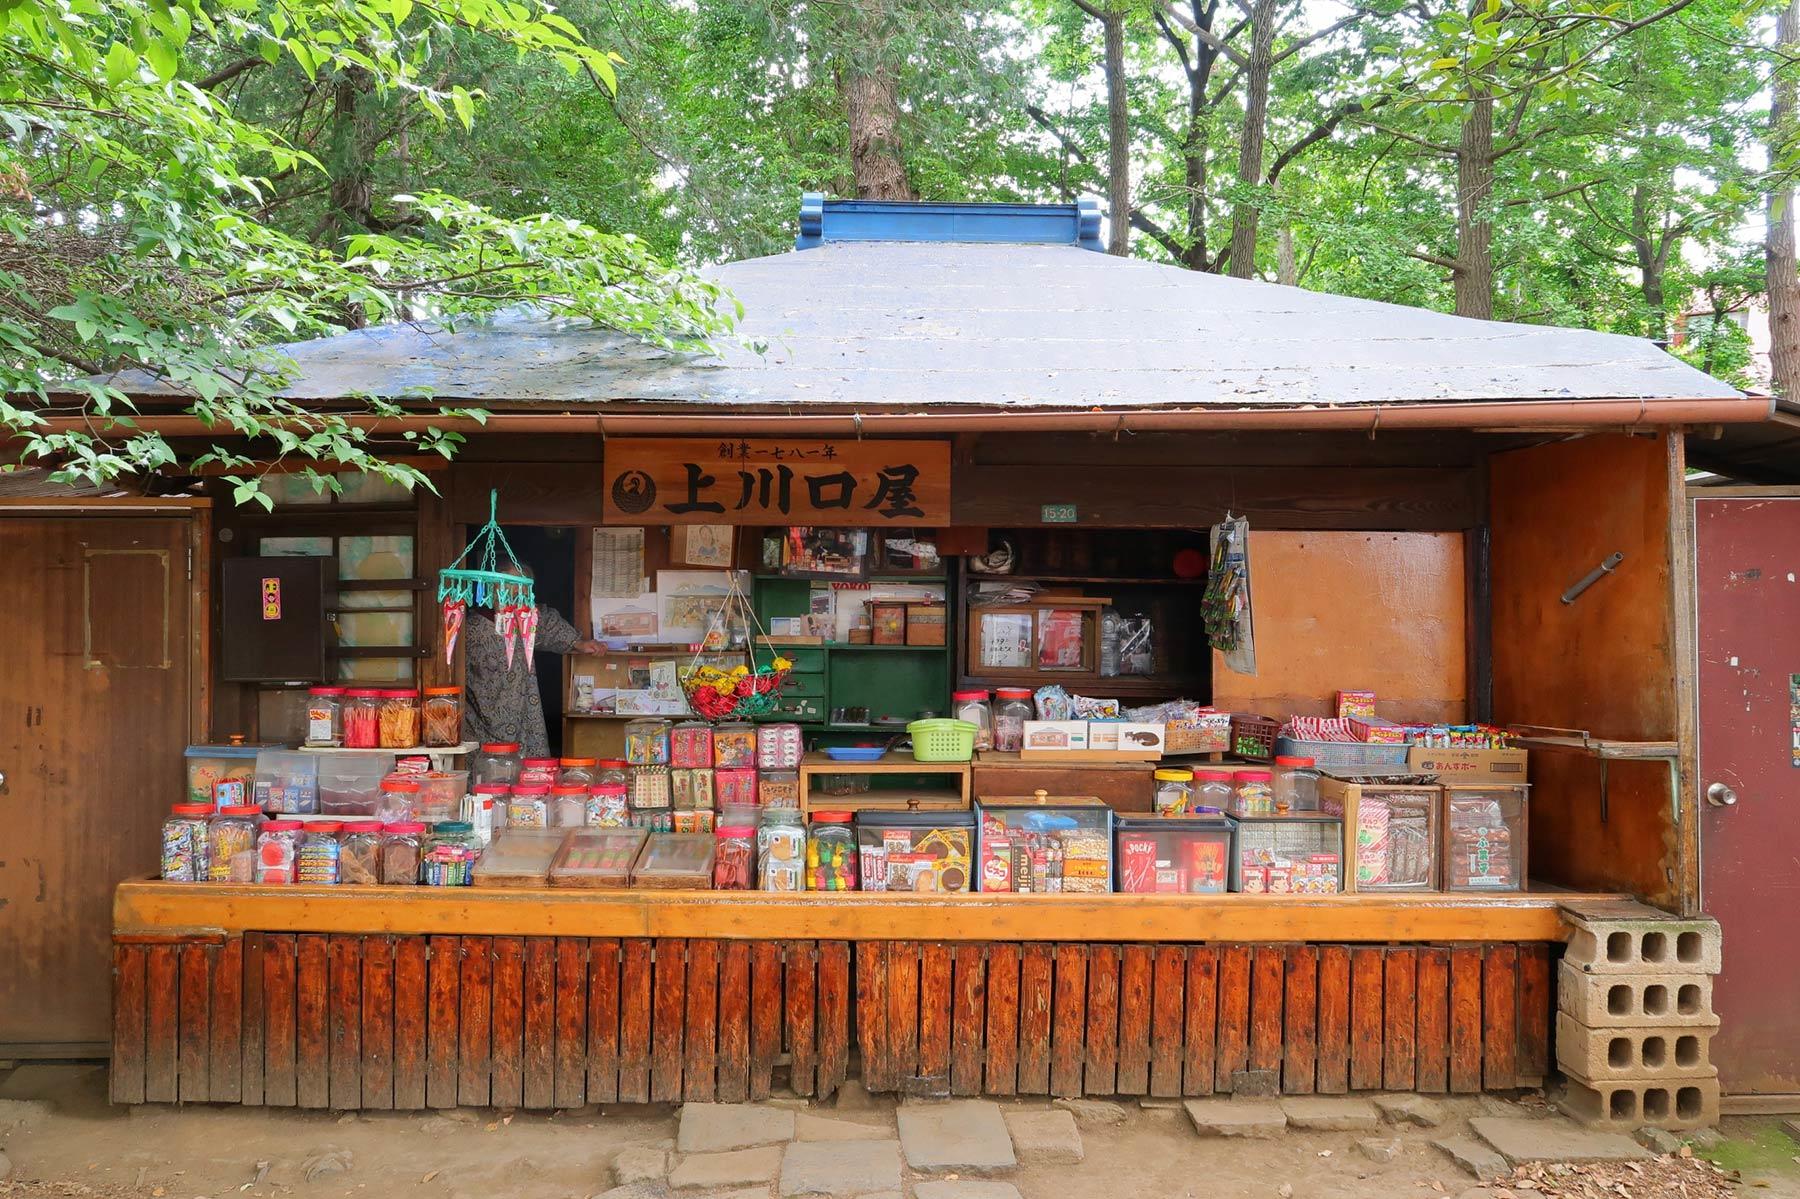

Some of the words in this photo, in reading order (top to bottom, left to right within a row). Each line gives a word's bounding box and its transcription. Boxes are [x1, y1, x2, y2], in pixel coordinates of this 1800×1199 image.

[717, 442, 838, 461] 創業一七八一年
[663, 463, 926, 519] 上川口屋
[1020, 854, 1031, 887] meiji
